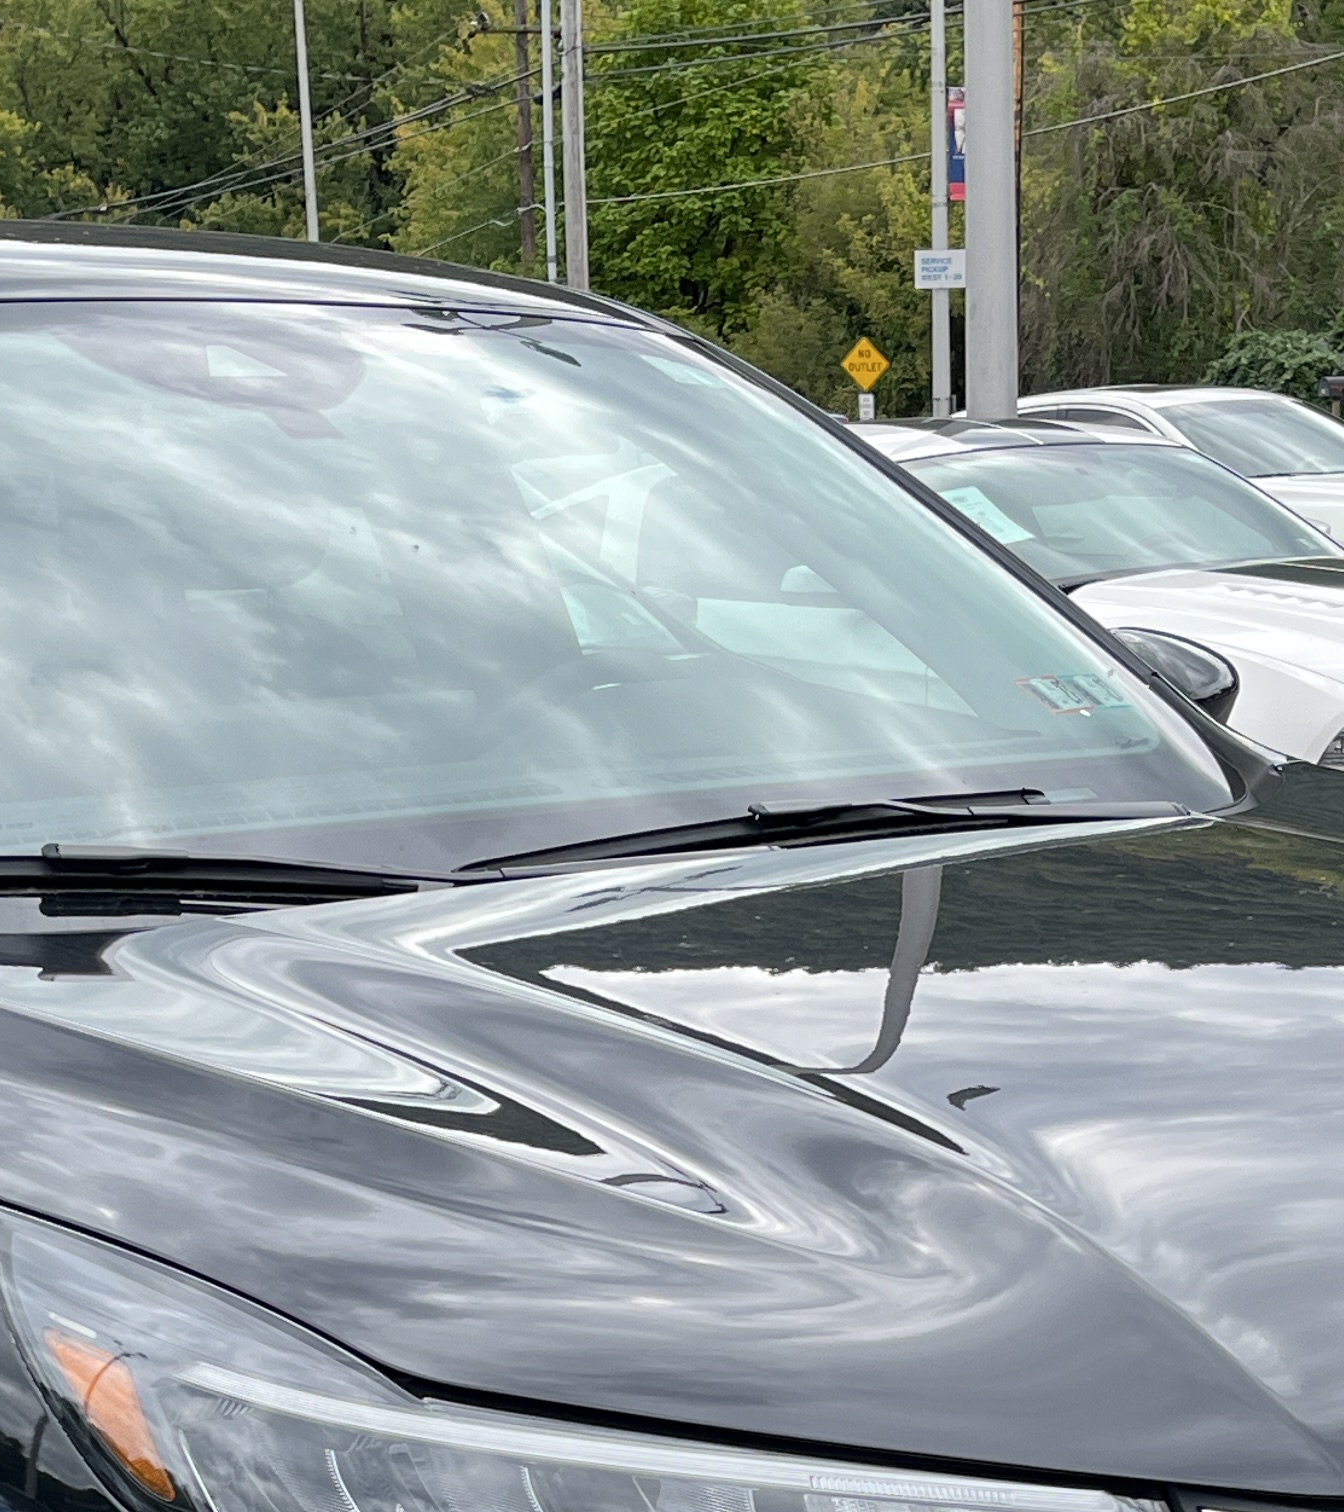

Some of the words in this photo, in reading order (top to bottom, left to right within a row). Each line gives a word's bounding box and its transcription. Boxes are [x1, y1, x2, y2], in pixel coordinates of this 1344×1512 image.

[921, 257, 952, 265] SERVICE
[921, 265, 949, 273] PICKUP
[858, 349, 871, 359] NO
[848, 361, 883, 373] OUTLET
